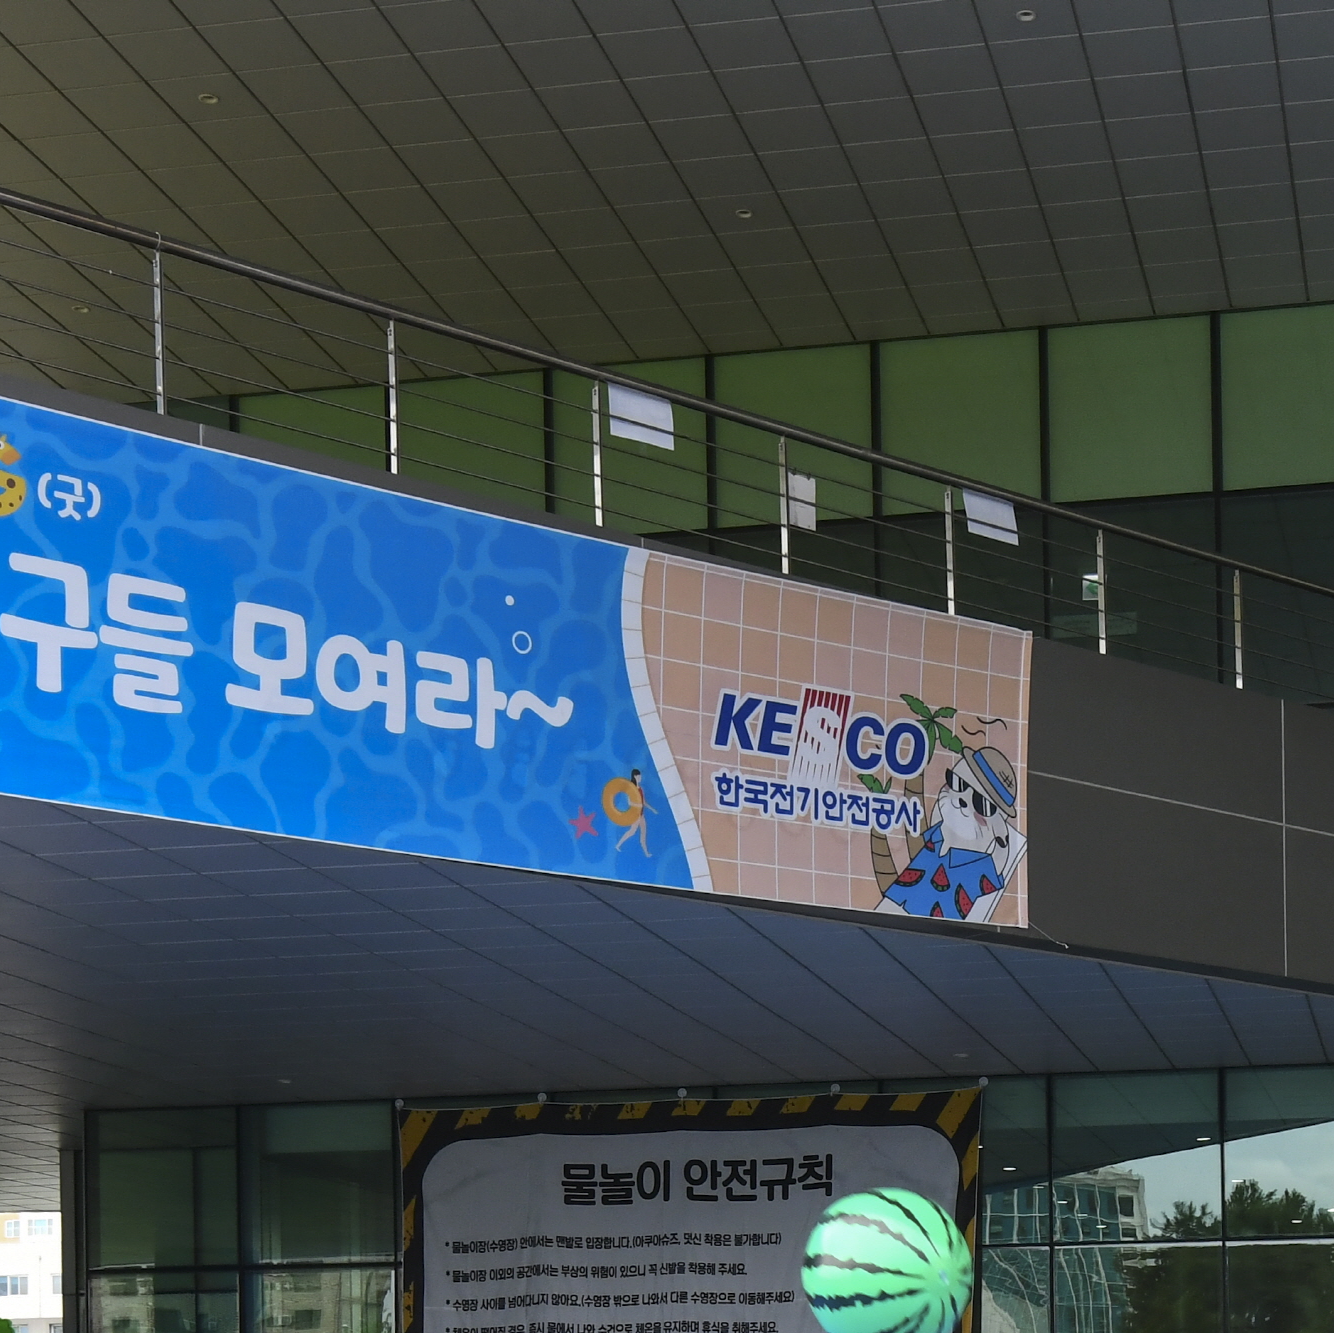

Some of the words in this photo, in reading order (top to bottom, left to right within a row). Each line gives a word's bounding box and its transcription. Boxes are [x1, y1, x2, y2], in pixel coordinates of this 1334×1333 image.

[225, 601, 574, 749] 모여라~
[712, 686, 928, 782] KESCO
[715, 772, 920, 832] 한국전기안전공사
[561, 1159, 670, 1206] 물놀이
[683, 1153, 833, 1202] 안전규칙
[520, 1235, 554, 1249] 안에서는
[556, 1235, 584, 1249] 맨발로
[704, 1233, 732, 1247] 착용은
[452, 1269, 487, 1283] 물놀이장
[489, 1267, 514, 1281] 이외의
[516, 1264, 559, 1279] 공간에서는
[561, 1265, 588, 1279] 부상의
[590, 1265, 617, 1279] 위험이
[619, 1265, 646, 1279] 있으니
[648, 1263, 658, 1277] 꼭
[659, 1261, 686, 1275] 신발을
[688, 1262, 716, 1276] 착용해
[452, 1299, 478, 1312] 수영장
[480, 1297, 506, 1311] 사이를
[508, 1294, 549, 1309] 넘어다니지
[613, 1294, 639, 1308] 밖으로
[642, 1291, 668, 1306] 나와서
[670, 1291, 688, 1304] 다른
[690, 1292, 736, 1305] 수영장으로
[663, 1320, 700, 1333] 유지하며
[702, 1320, 729, 1333] 휴식을
